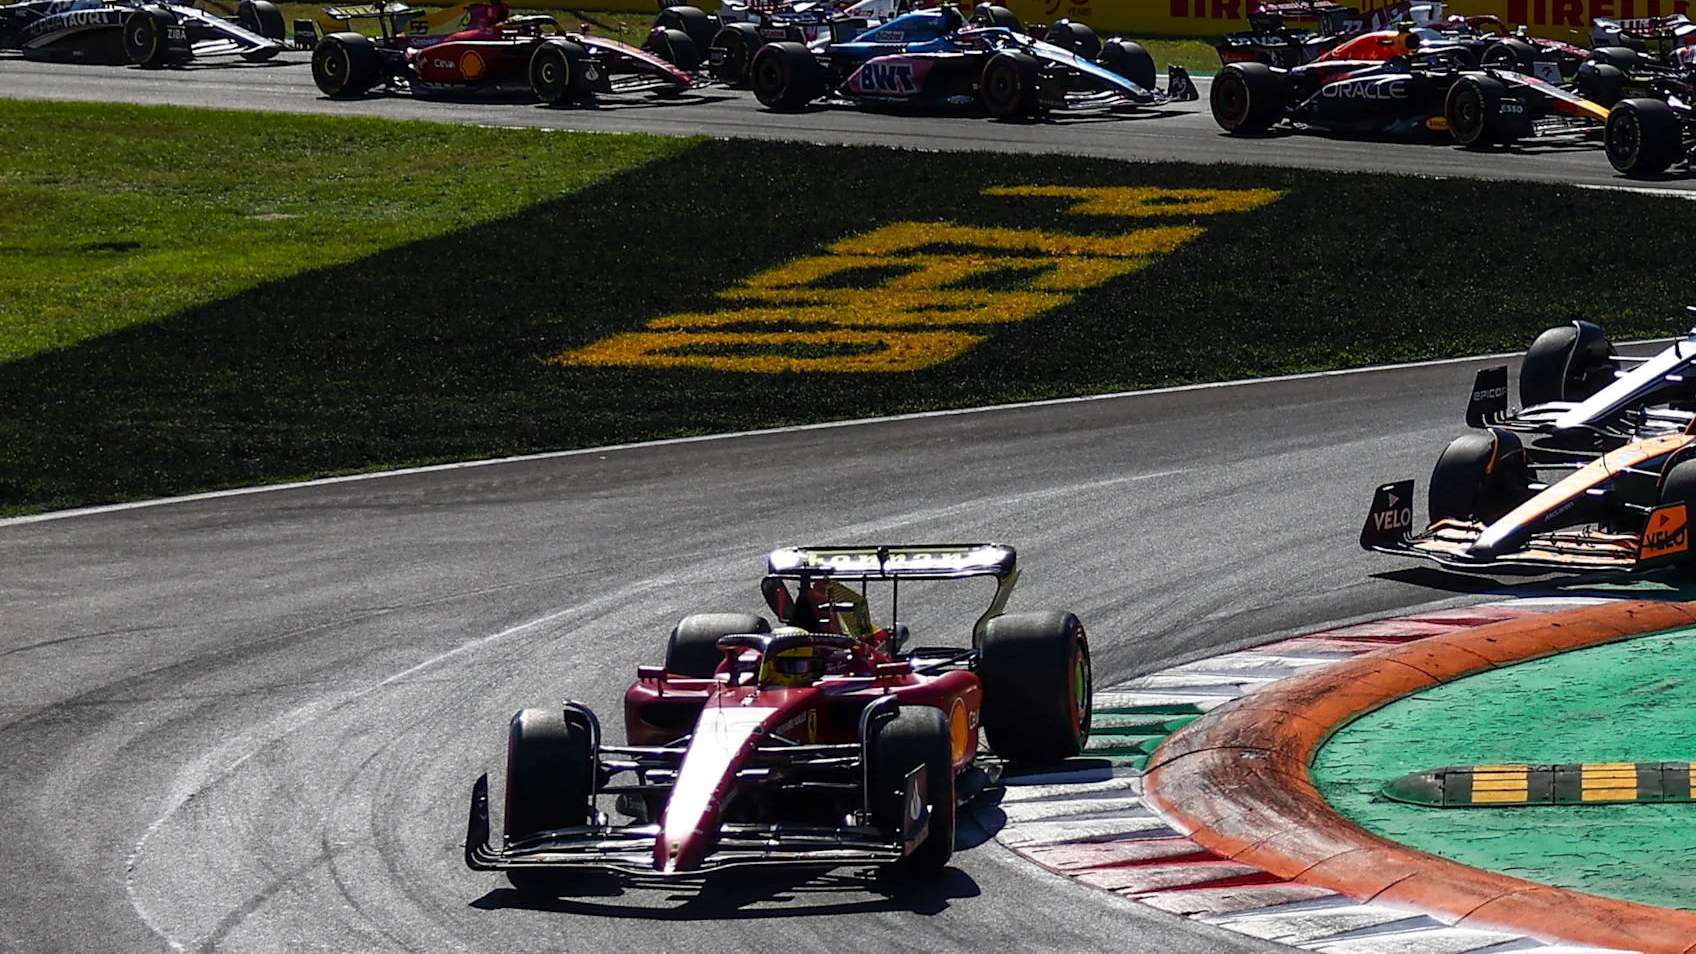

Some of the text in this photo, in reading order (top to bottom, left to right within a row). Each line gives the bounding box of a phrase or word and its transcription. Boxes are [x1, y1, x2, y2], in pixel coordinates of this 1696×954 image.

[1067, 8, 1092, 17] YEARS
[409, 20, 429, 36] 55
[862, 64, 917, 94] BWT
[1321, 80, 1410, 100] ORACLE
[1500, 104, 1524, 114] ESSO
[1374, 507, 1412, 531] VELO
[1646, 527, 1687, 551] VELO
